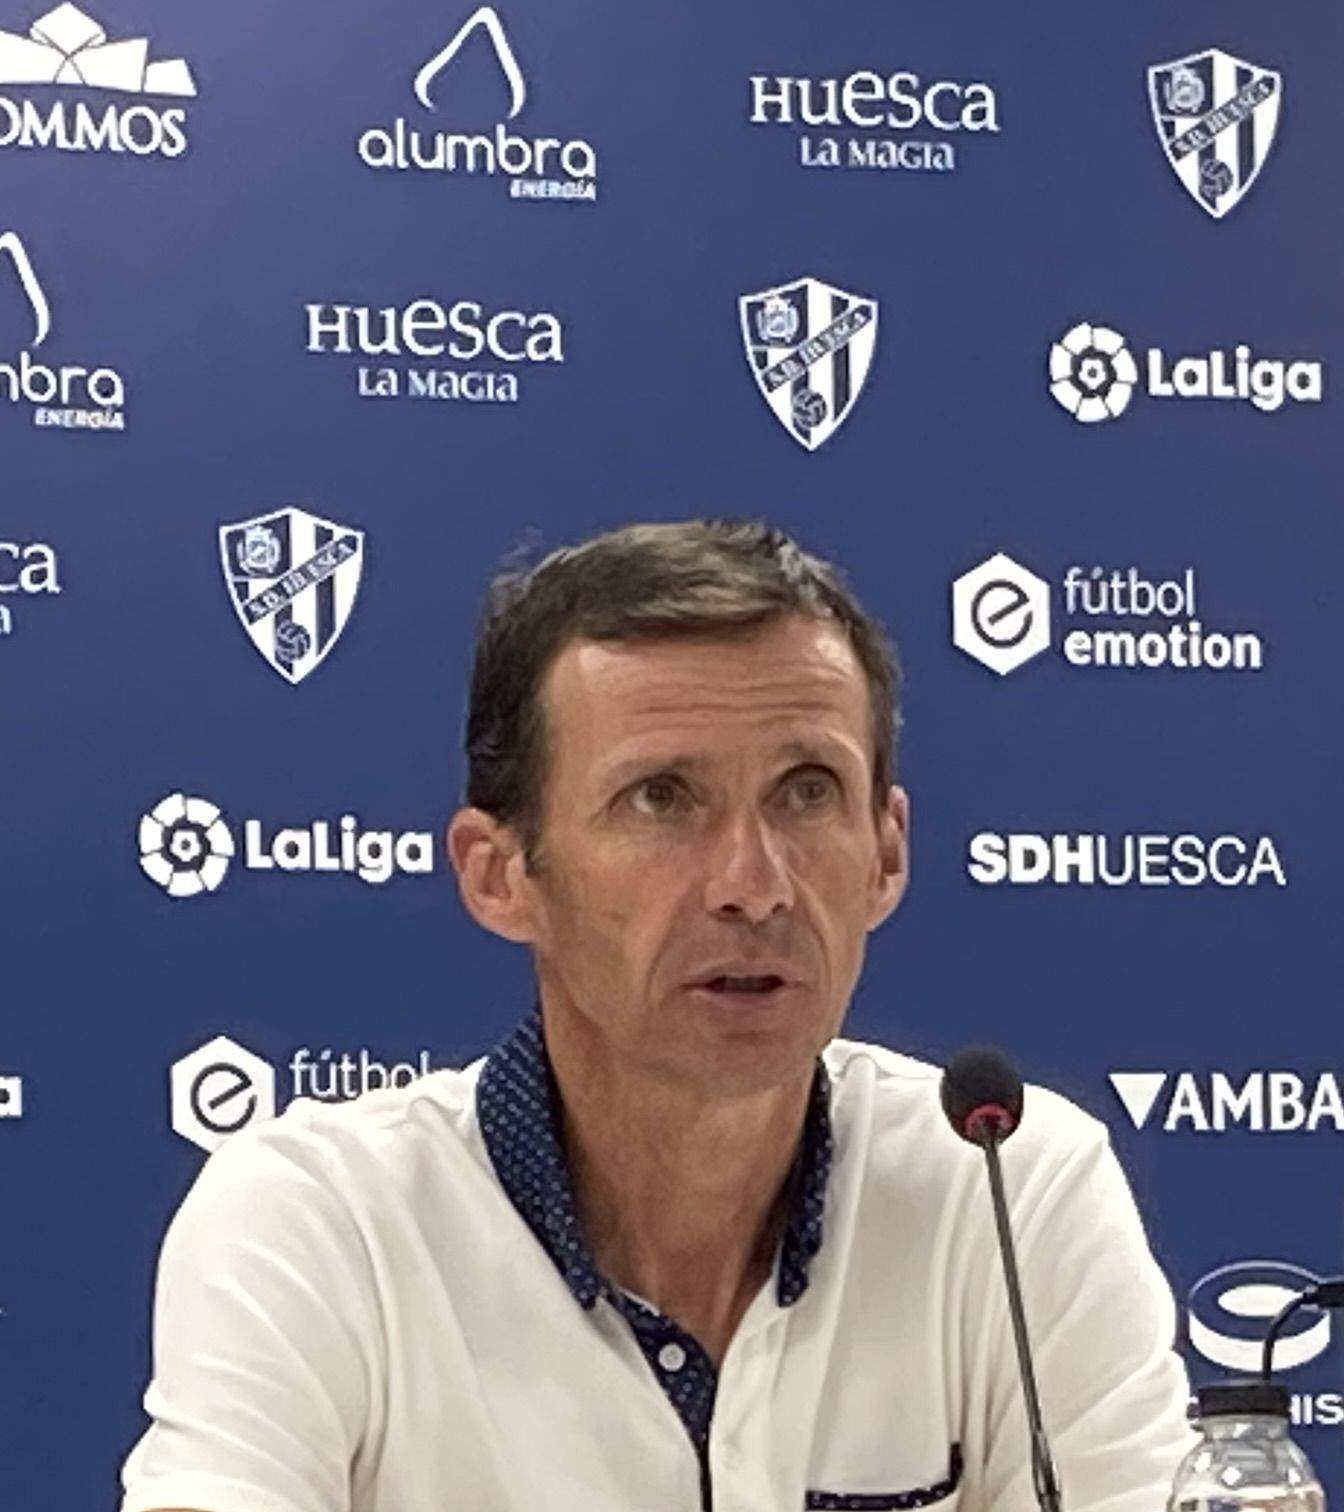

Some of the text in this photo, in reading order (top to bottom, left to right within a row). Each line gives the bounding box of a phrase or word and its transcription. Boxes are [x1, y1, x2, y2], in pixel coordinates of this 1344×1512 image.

[358, 117, 596, 178] alumbra
[1148, 345, 1322, 411] LaLiga
[1063, 566, 1195, 617] fútbol
[1064, 621, 1262, 668] emotion
[245, 815, 433, 883] LaLiga
[968, 833, 1287, 886] SDHUESCA
